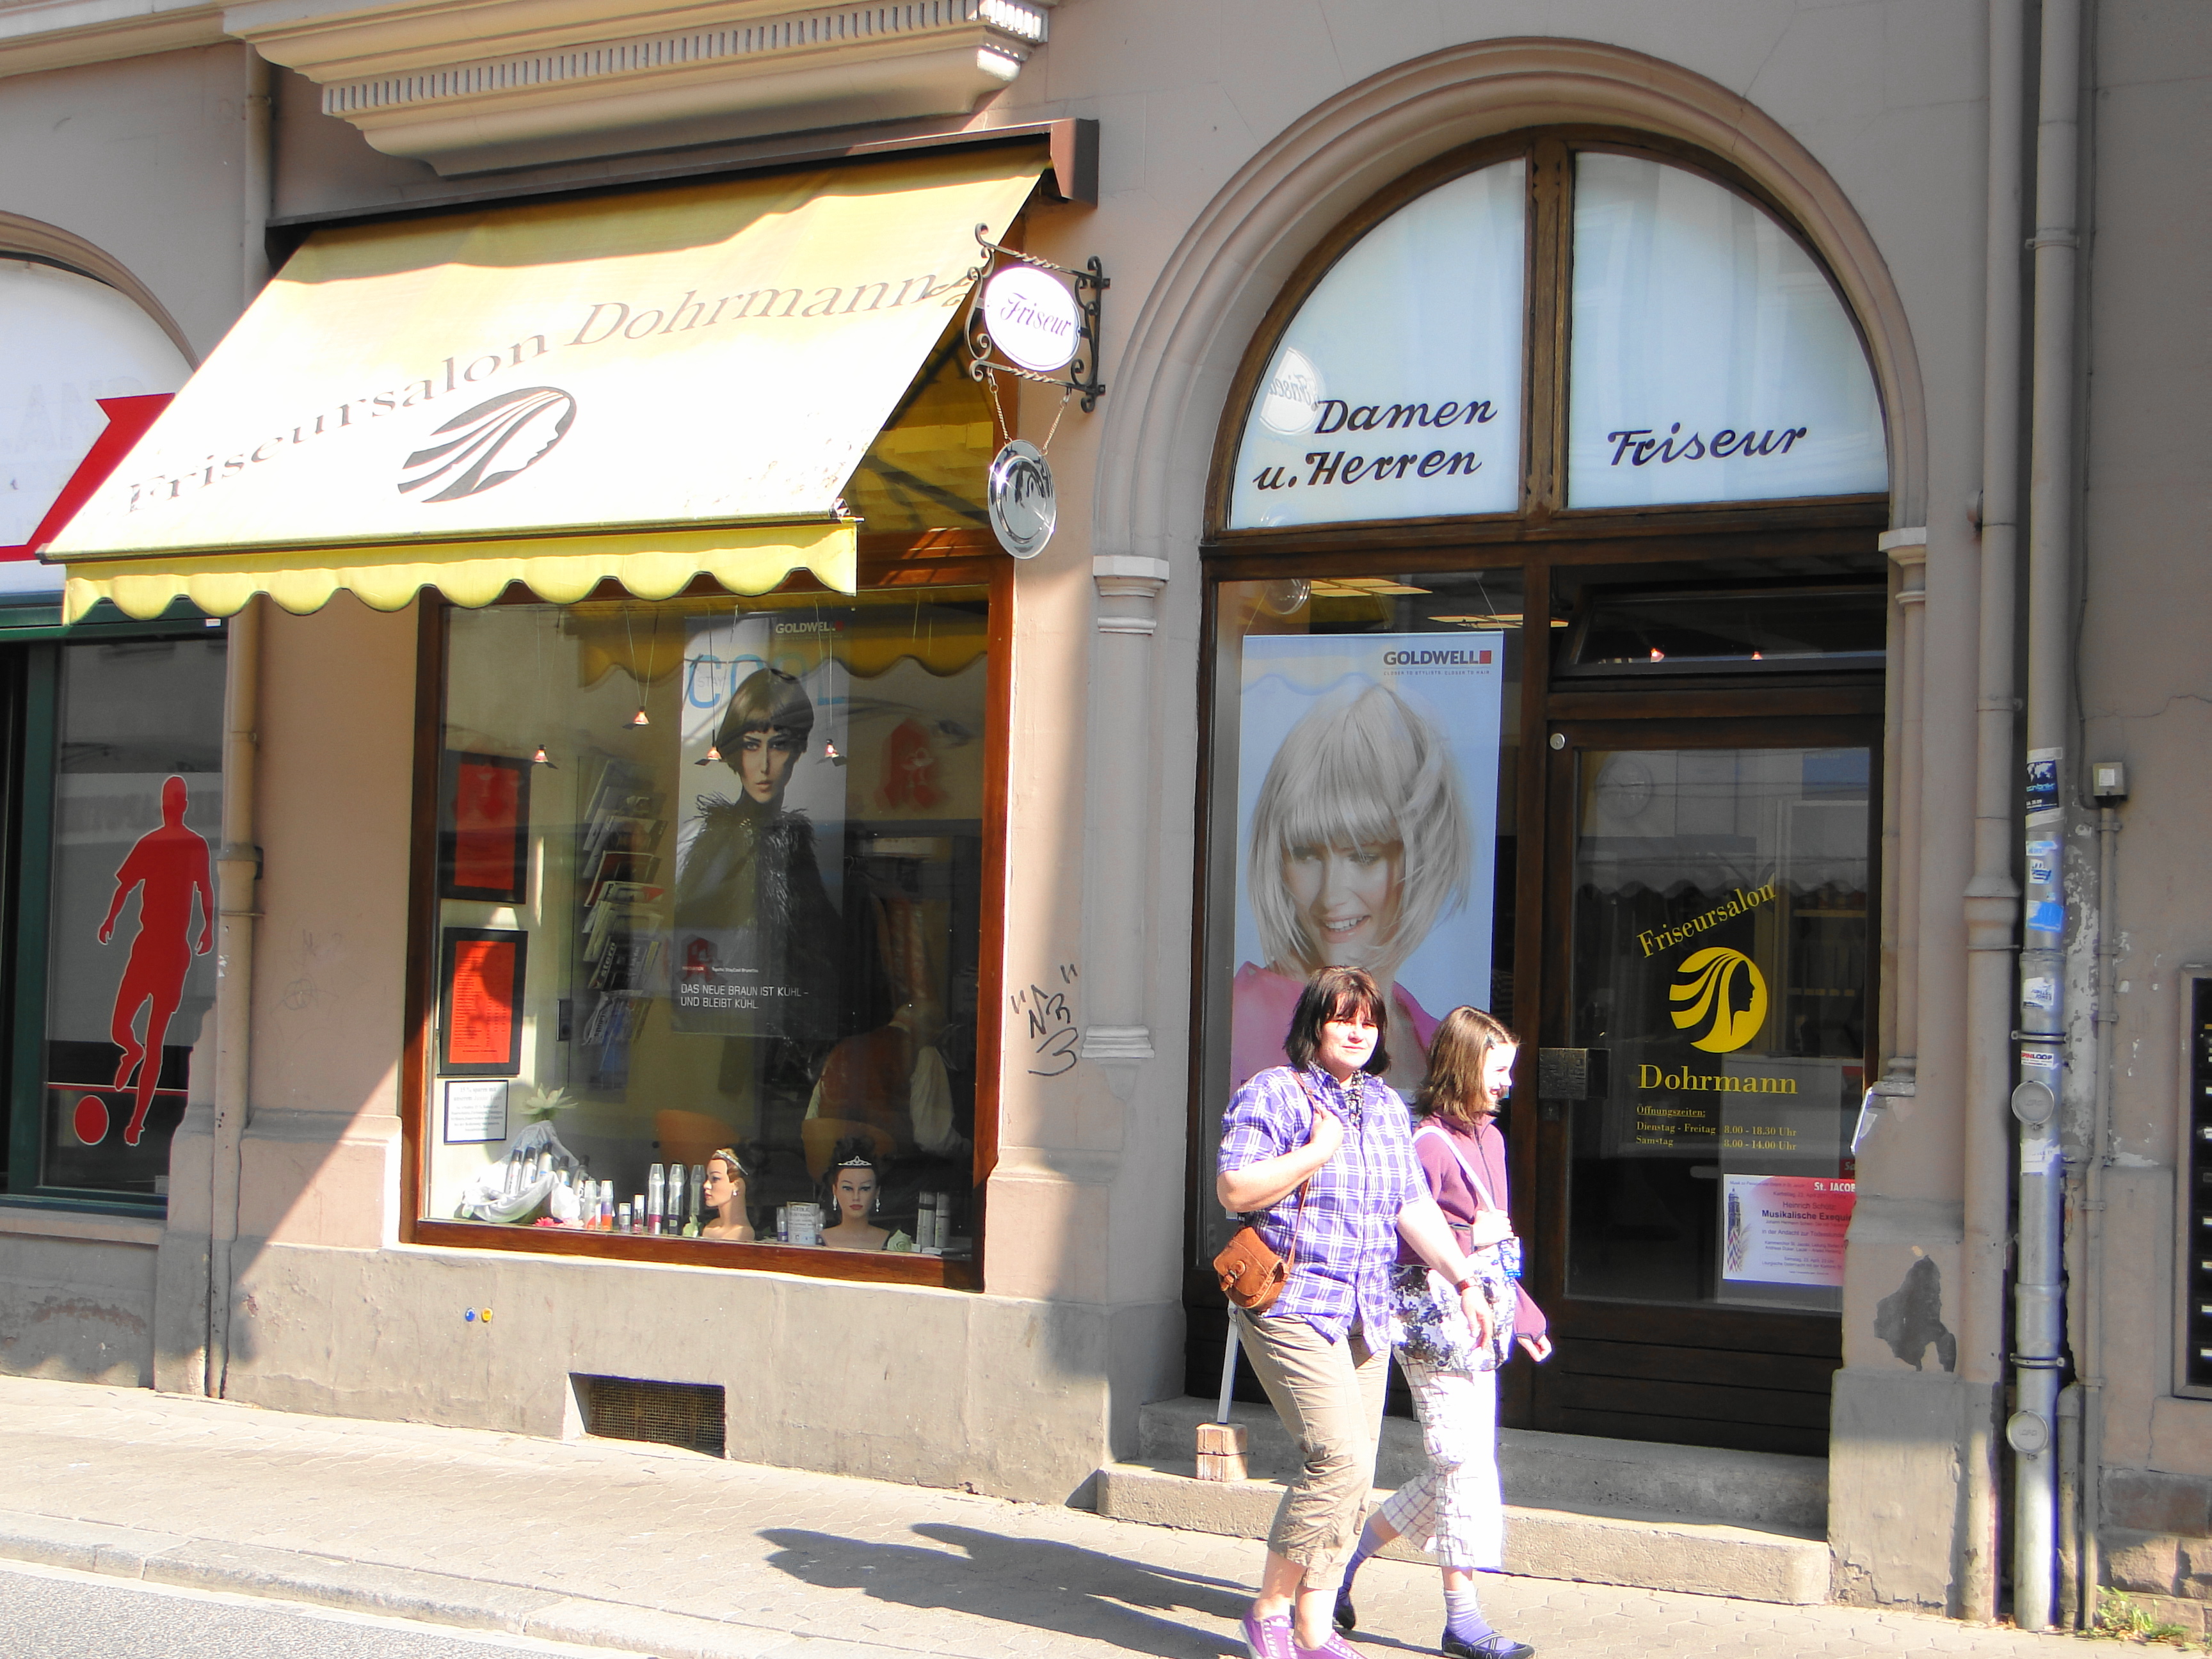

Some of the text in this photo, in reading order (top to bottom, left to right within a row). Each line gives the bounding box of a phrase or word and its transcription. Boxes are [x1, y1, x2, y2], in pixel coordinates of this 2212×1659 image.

[1000, 292, 1071, 337] Friseur
[126, 333, 550, 517] Friseursalon
[565, 274, 938, 347] Dohrmann
[1313, 396, 1498, 436] Damen
[1607, 421, 1808, 468] Friseur
[1383, 650, 1479, 665] GOLDWELL
[698, 676, 724, 688] STAY
[1636, 881, 1776, 958] Friseursalon
[680, 983, 700, 993] DAS
[702, 984, 726, 995] NEUE
[728, 985, 758, 996] BRAUN
[760, 986, 774, 997] IST
[777, 984, 802, 997] KÜHL
[680, 996, 759, 1009] UND BLEIBT KÜHL.
[1637, 1063, 1798, 1095] Dohrmann
[1636, 1103, 1706, 1118] Öffnungszeiten:
[1636, 1121, 1676, 1134] Dienstag
[1684, 1123, 1716, 1135] Freitag
[1724, 1125, 1743, 1134] 8.00
[1752, 1126, 1776, 1135] 18.30
[1779, 1126, 1797, 1137] Uhr
[1636, 1135, 1674, 1148] Samstag
[1724, 1139, 1743, 1148] 8.00
[1752, 1140, 1776, 1149] 14.00
[1778, 1141, 1797, 1150] Uhr
[1814, 1182, 1826, 1191] St.
[1762, 1210, 1816, 1219] Musikalische
